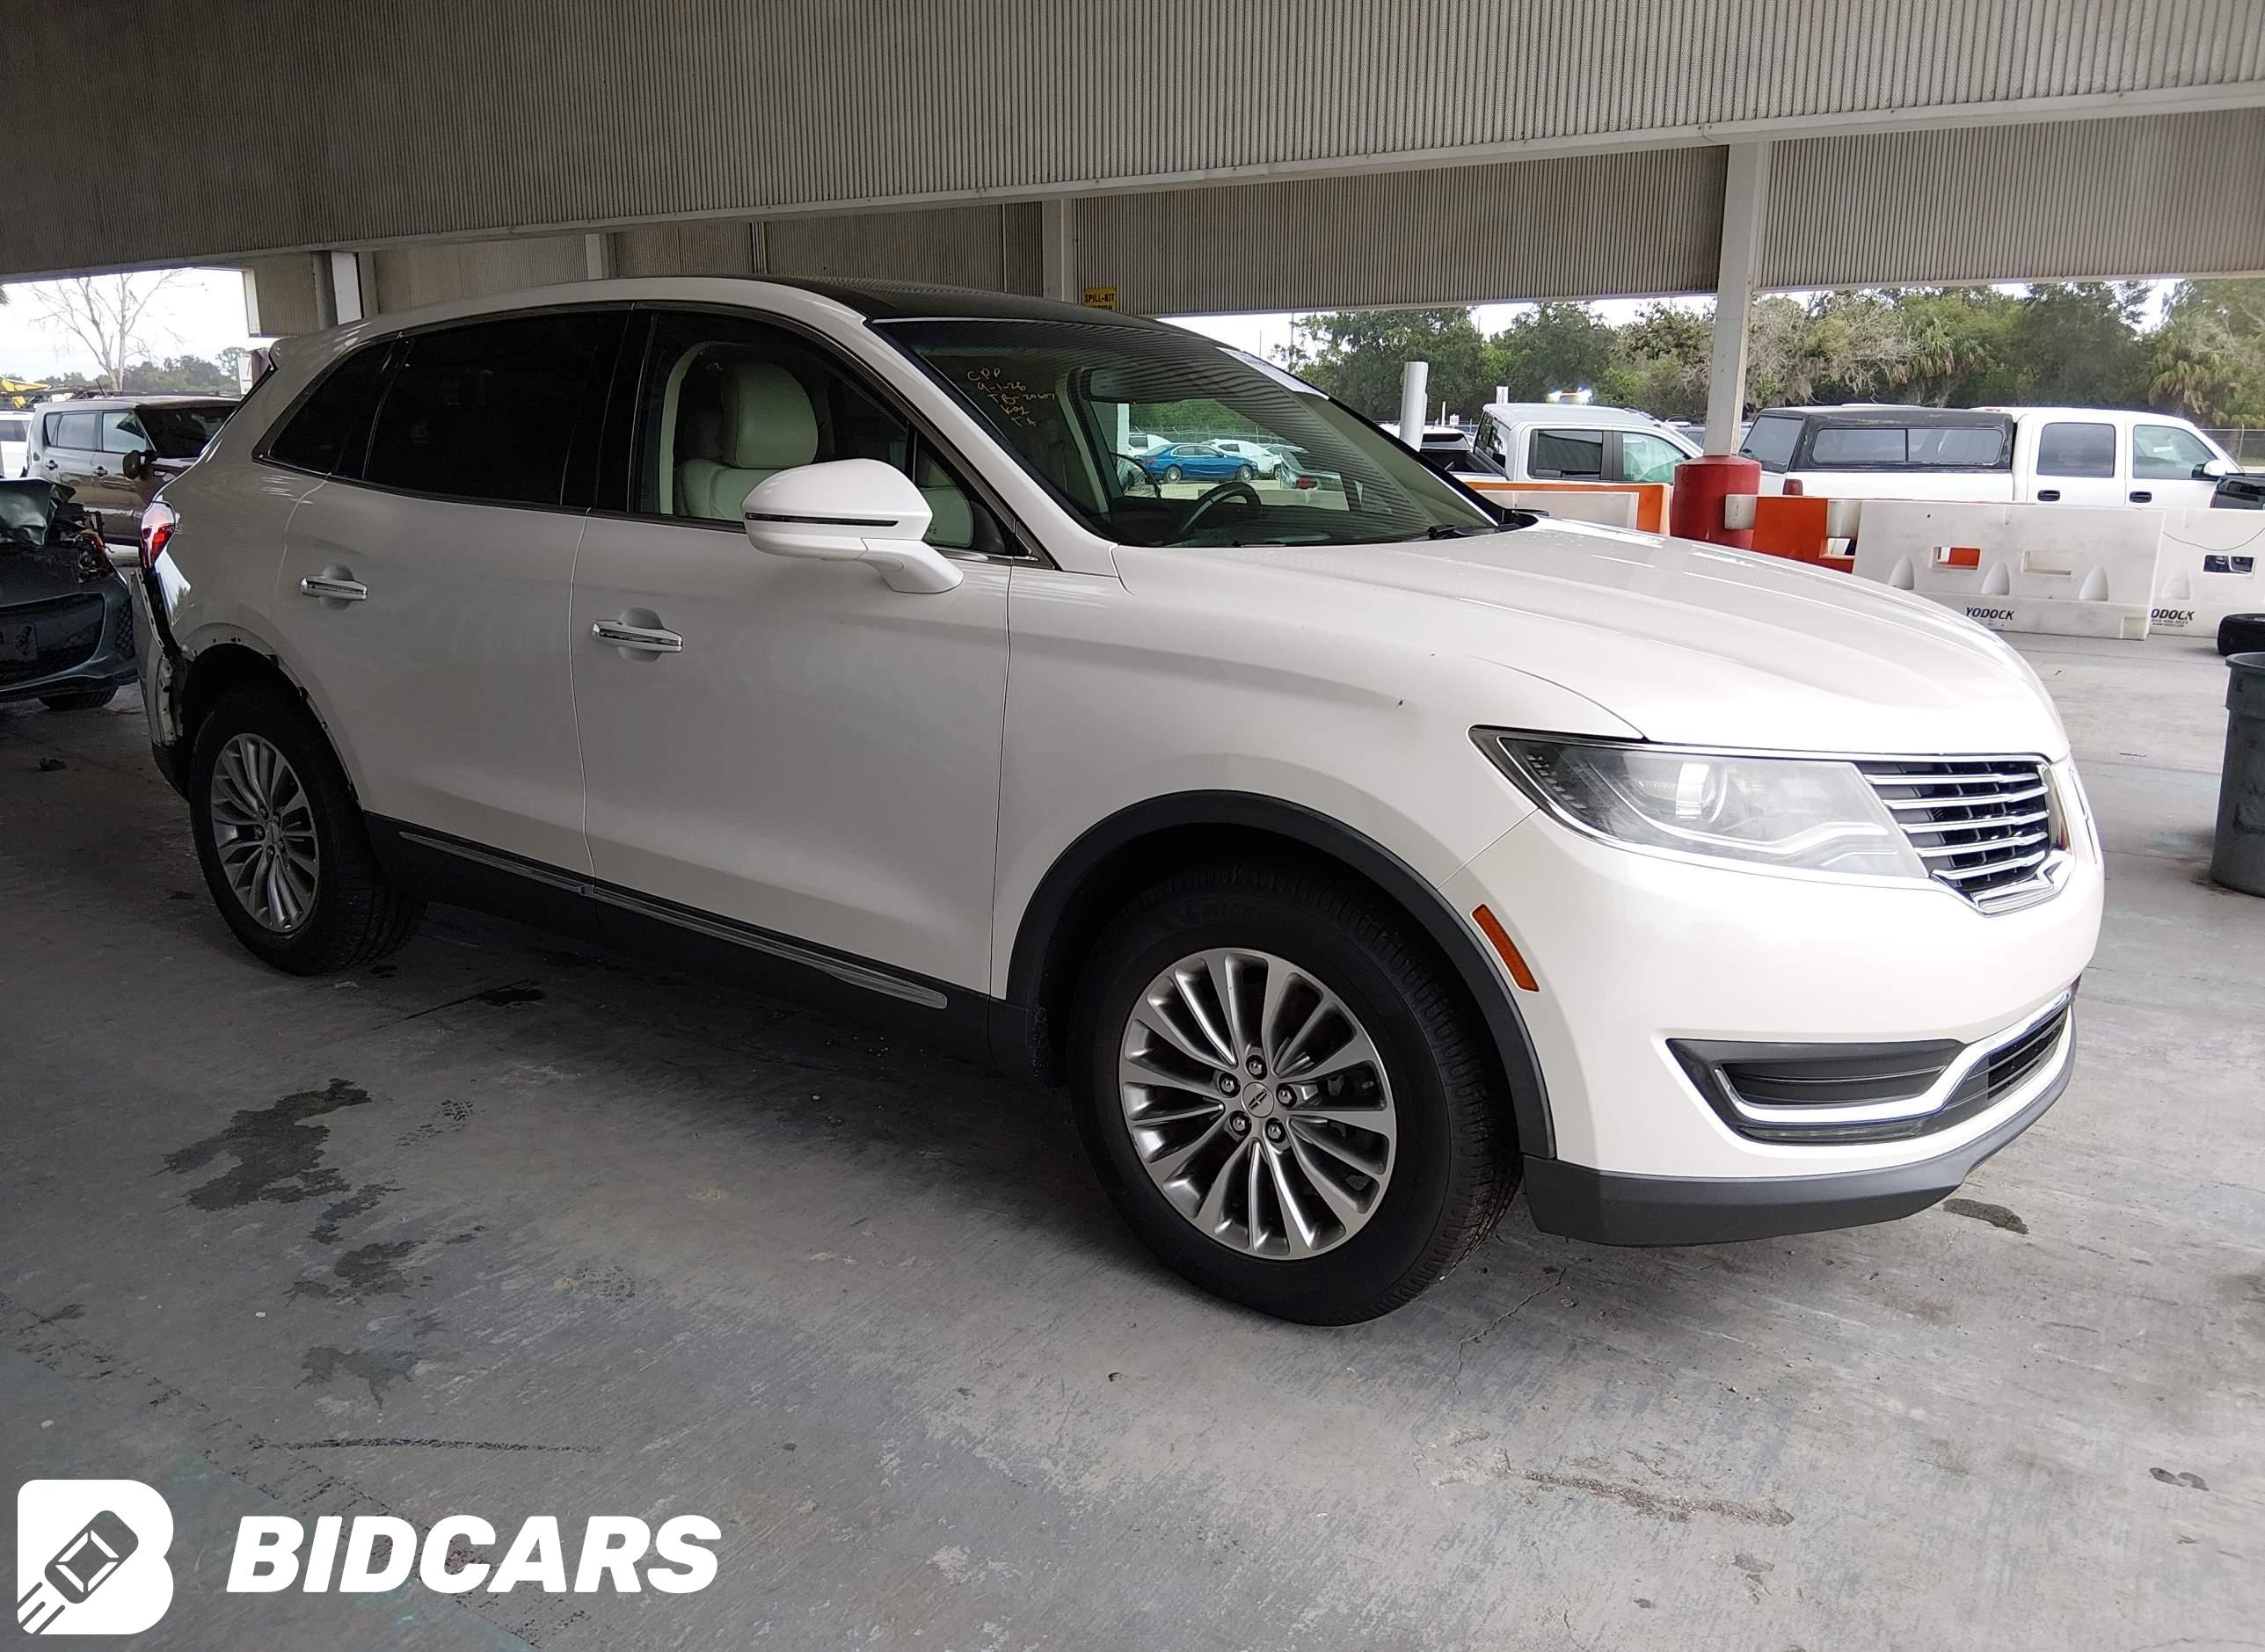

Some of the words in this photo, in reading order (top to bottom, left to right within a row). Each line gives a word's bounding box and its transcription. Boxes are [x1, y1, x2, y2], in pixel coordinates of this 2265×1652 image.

[1084, 293, 1115, 303] SPILL-KIT
[1966, 607, 2014, 620] YODOCK
[2151, 608, 2195, 621] ODOCK
